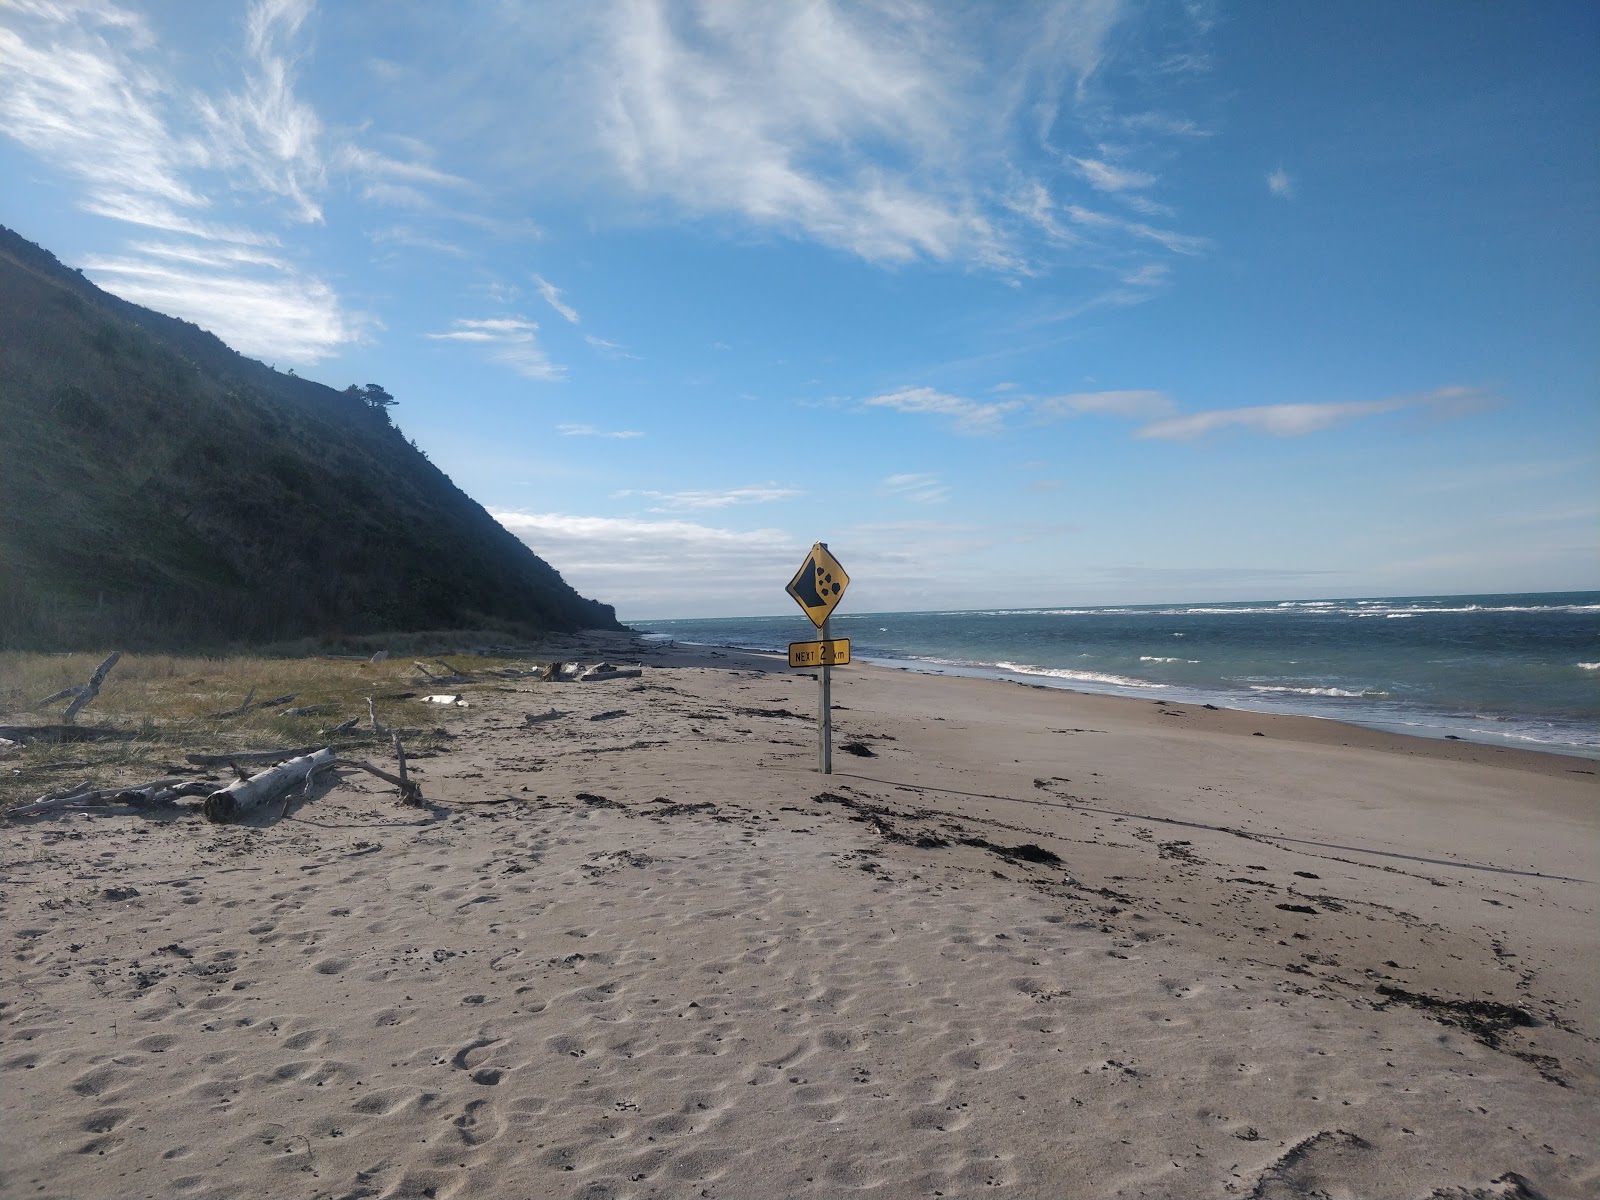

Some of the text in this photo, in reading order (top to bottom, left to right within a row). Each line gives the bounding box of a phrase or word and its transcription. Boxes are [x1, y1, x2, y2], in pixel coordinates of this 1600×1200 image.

[795, 646, 845, 662] NEXT 2 km
